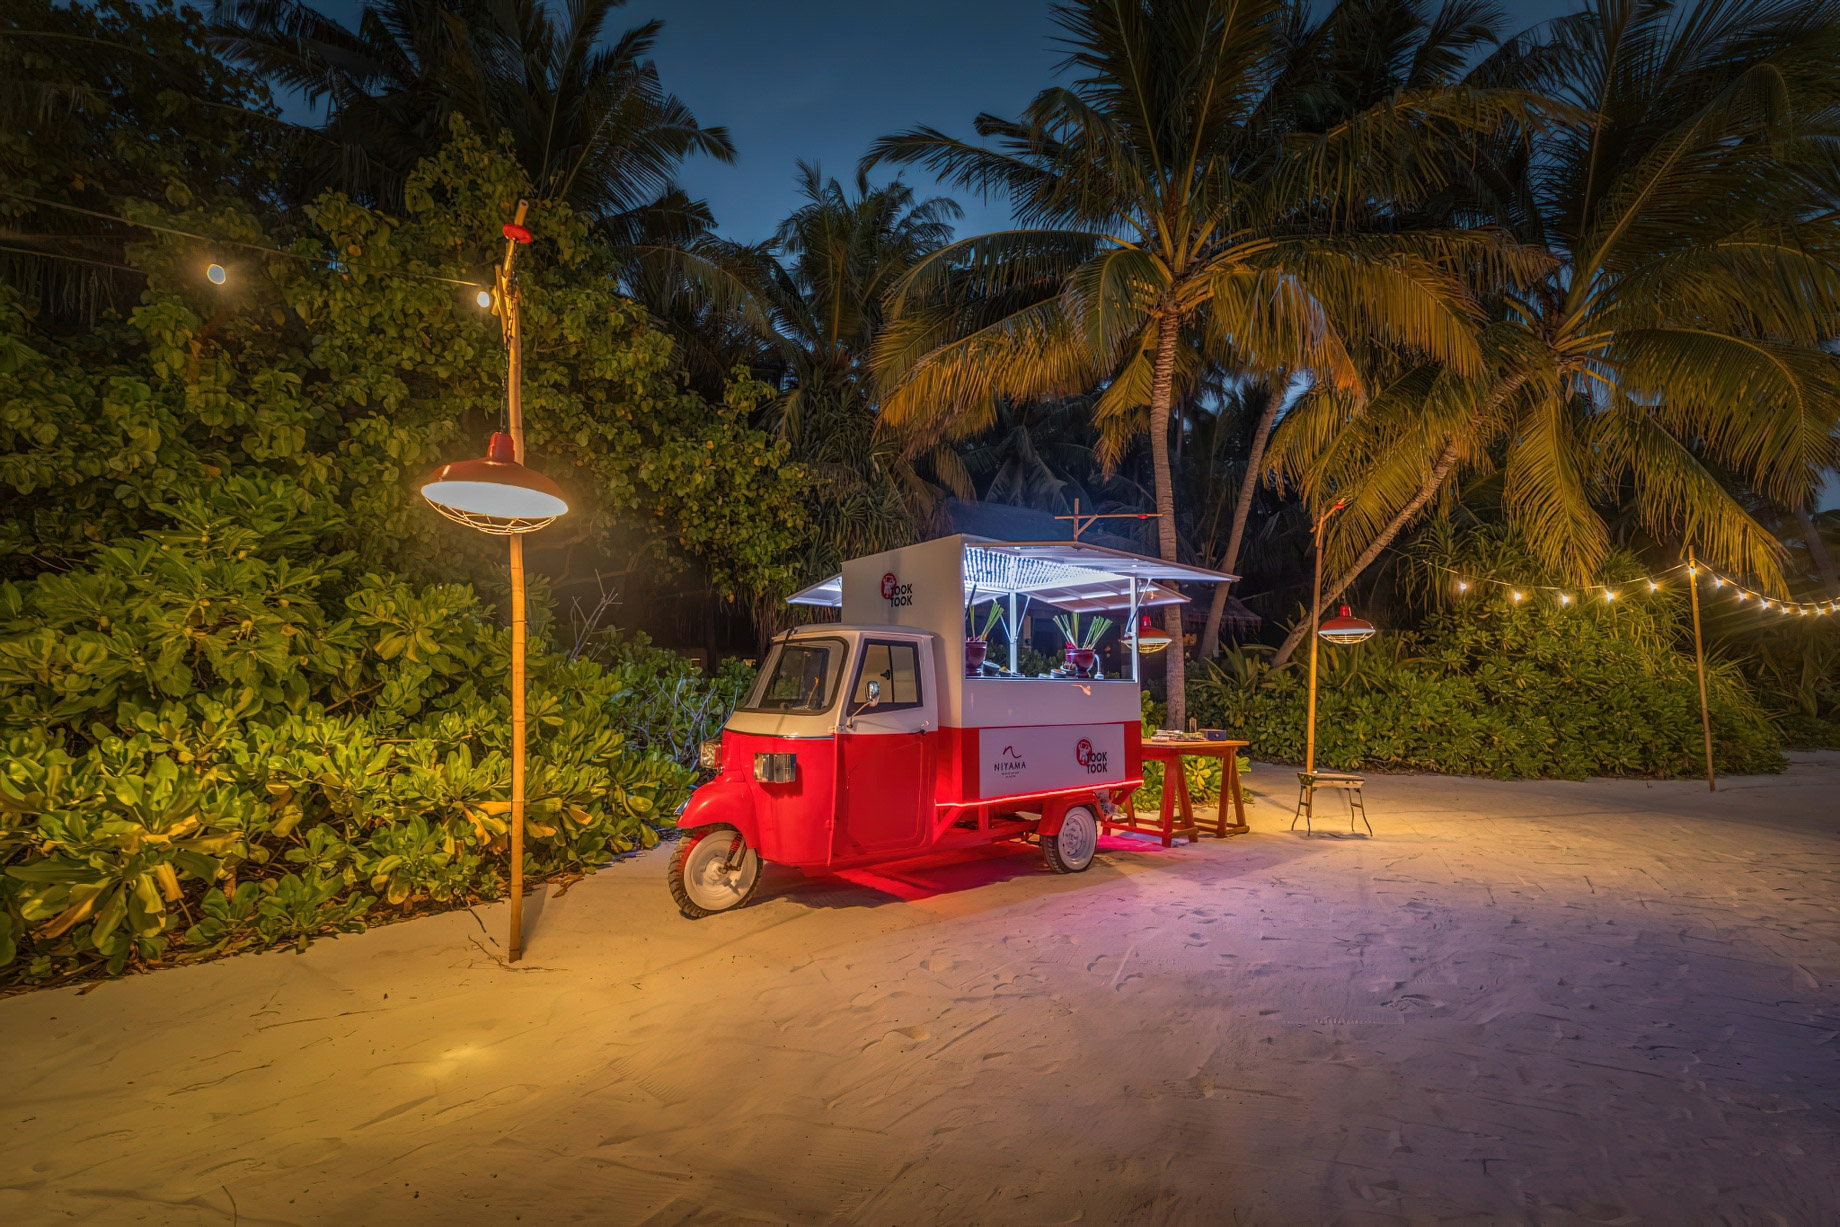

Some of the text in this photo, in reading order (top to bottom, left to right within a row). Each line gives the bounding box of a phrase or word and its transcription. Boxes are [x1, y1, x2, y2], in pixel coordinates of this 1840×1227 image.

[890, 595, 912, 607] TOOK
[994, 761, 1026, 771] NIYAMA
[1087, 763, 1107, 774] TOOK
